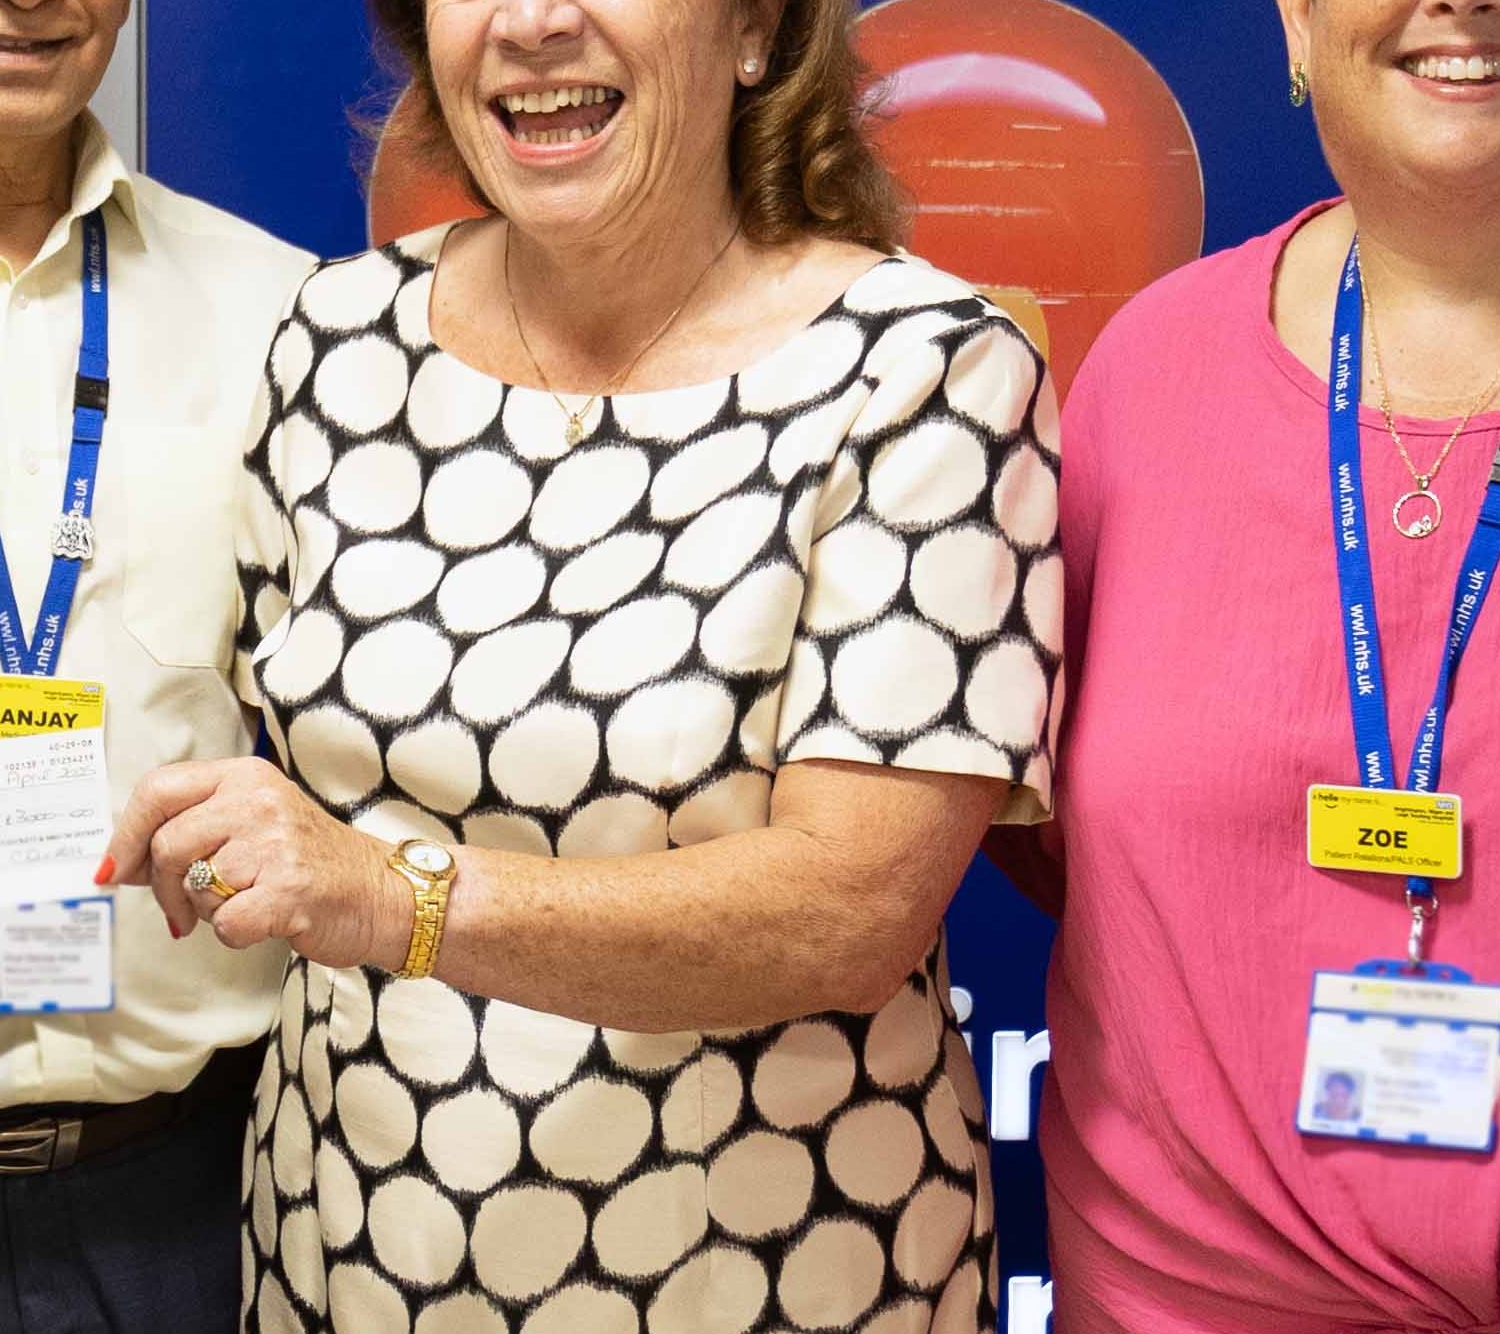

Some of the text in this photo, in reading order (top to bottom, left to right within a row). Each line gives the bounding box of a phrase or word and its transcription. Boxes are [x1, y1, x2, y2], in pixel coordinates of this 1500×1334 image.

[1335, 333, 1351, 412] wwl.nhs.uk
[1338, 462, 1360, 552] wwl.nhs.uk
[1350, 603, 1375, 696] wwl.nhs.uk
[1358, 827, 1408, 849] ZOE
